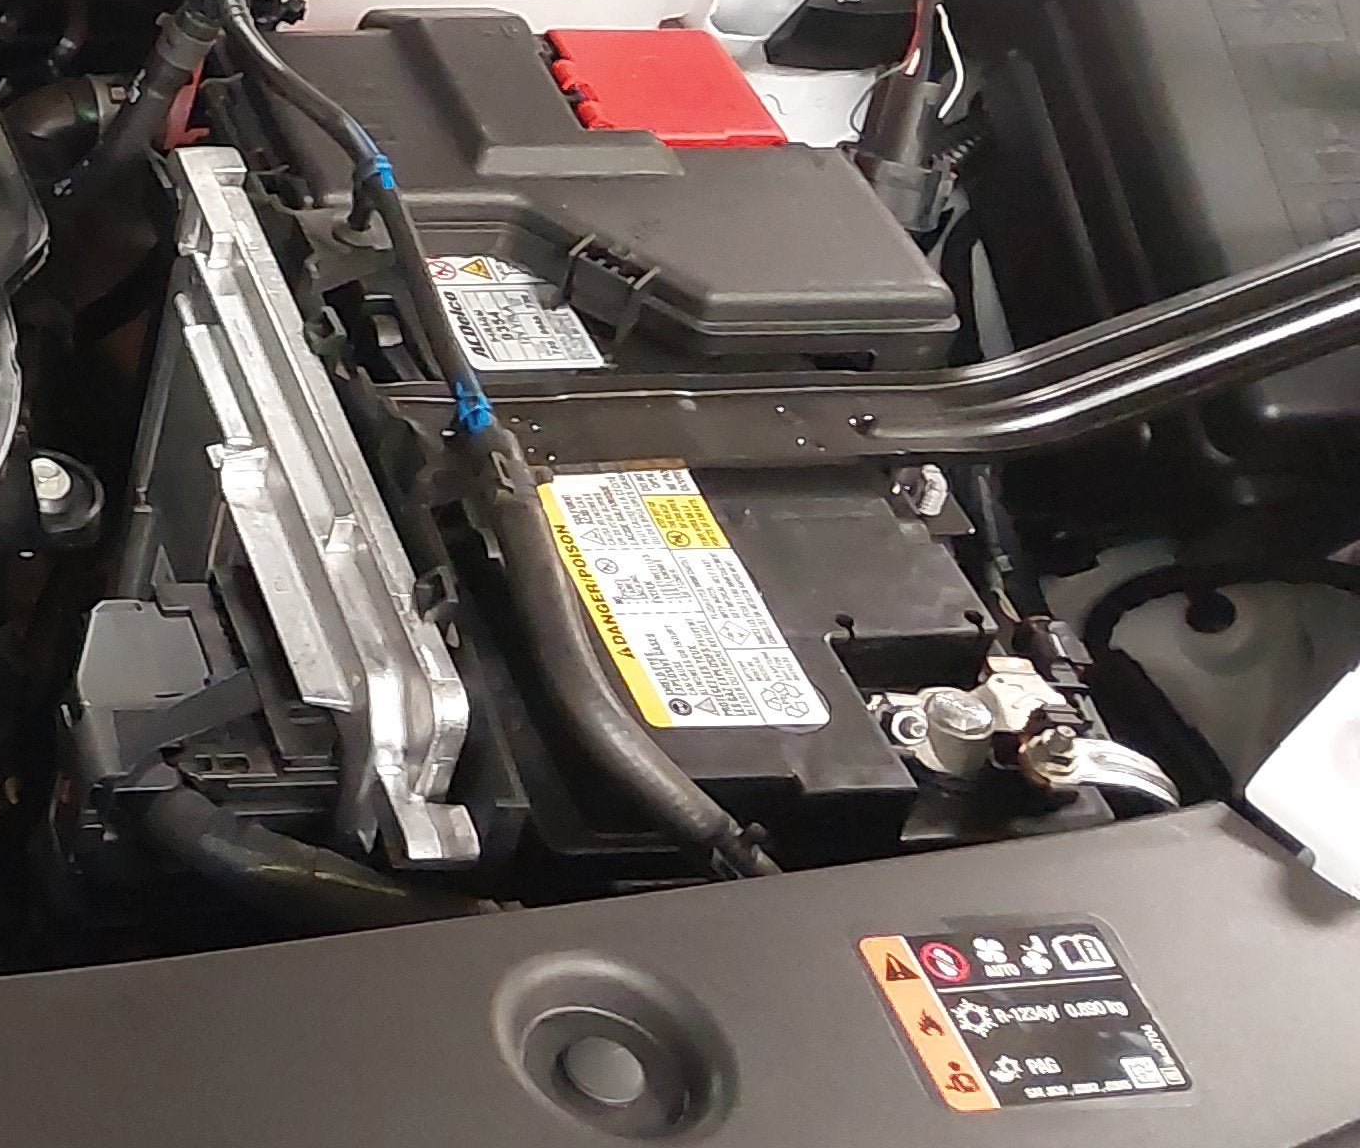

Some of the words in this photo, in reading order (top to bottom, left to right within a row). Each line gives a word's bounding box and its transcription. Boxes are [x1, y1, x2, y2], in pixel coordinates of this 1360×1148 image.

[443, 291, 490, 359] ACDelco
[553, 524, 627, 644] DANGER/POISON
[984, 963, 1021, 977] AUTO
[993, 1004, 1061, 1023] R-1234yf
[1025, 1057, 1062, 1075] PAG
